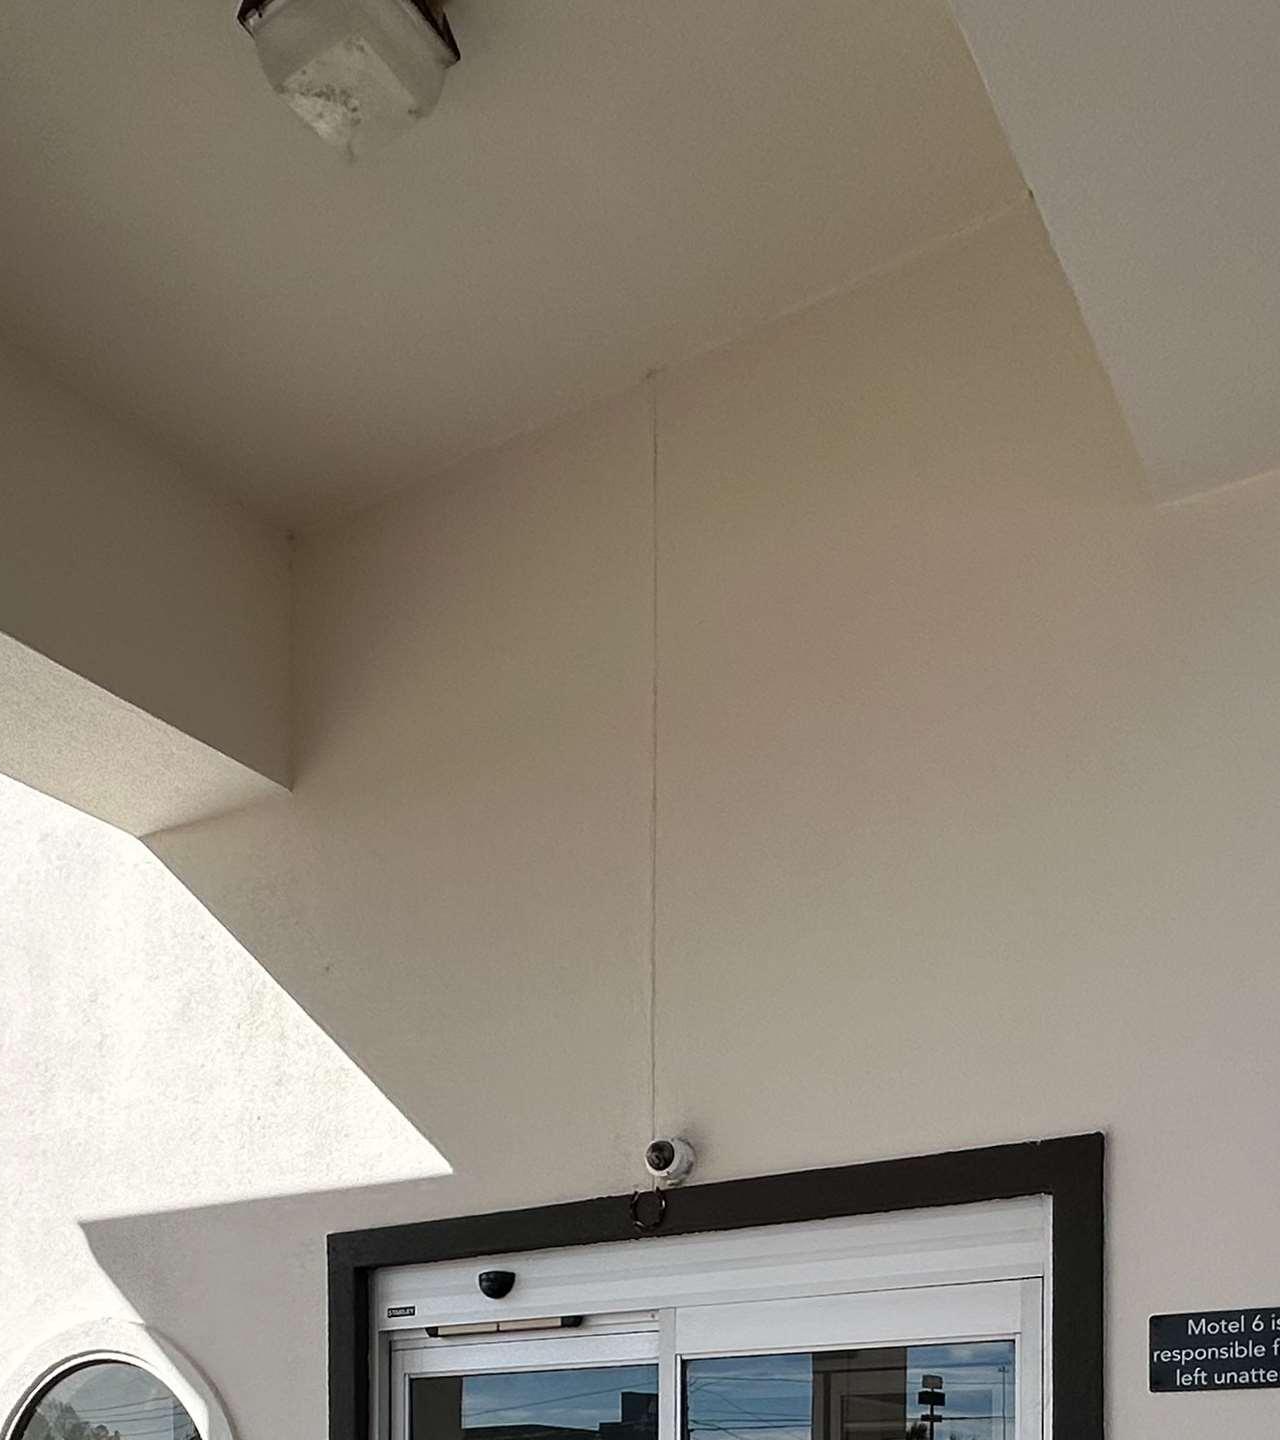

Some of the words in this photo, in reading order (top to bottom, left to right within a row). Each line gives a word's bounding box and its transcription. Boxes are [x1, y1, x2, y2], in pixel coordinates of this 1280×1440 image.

[1187, 1315, 1245, 1336] Motel
[1251, 1314, 1265, 1333] 6
[1153, 1340, 1266, 1365] responsible
[1176, 1367, 1208, 1386] left
